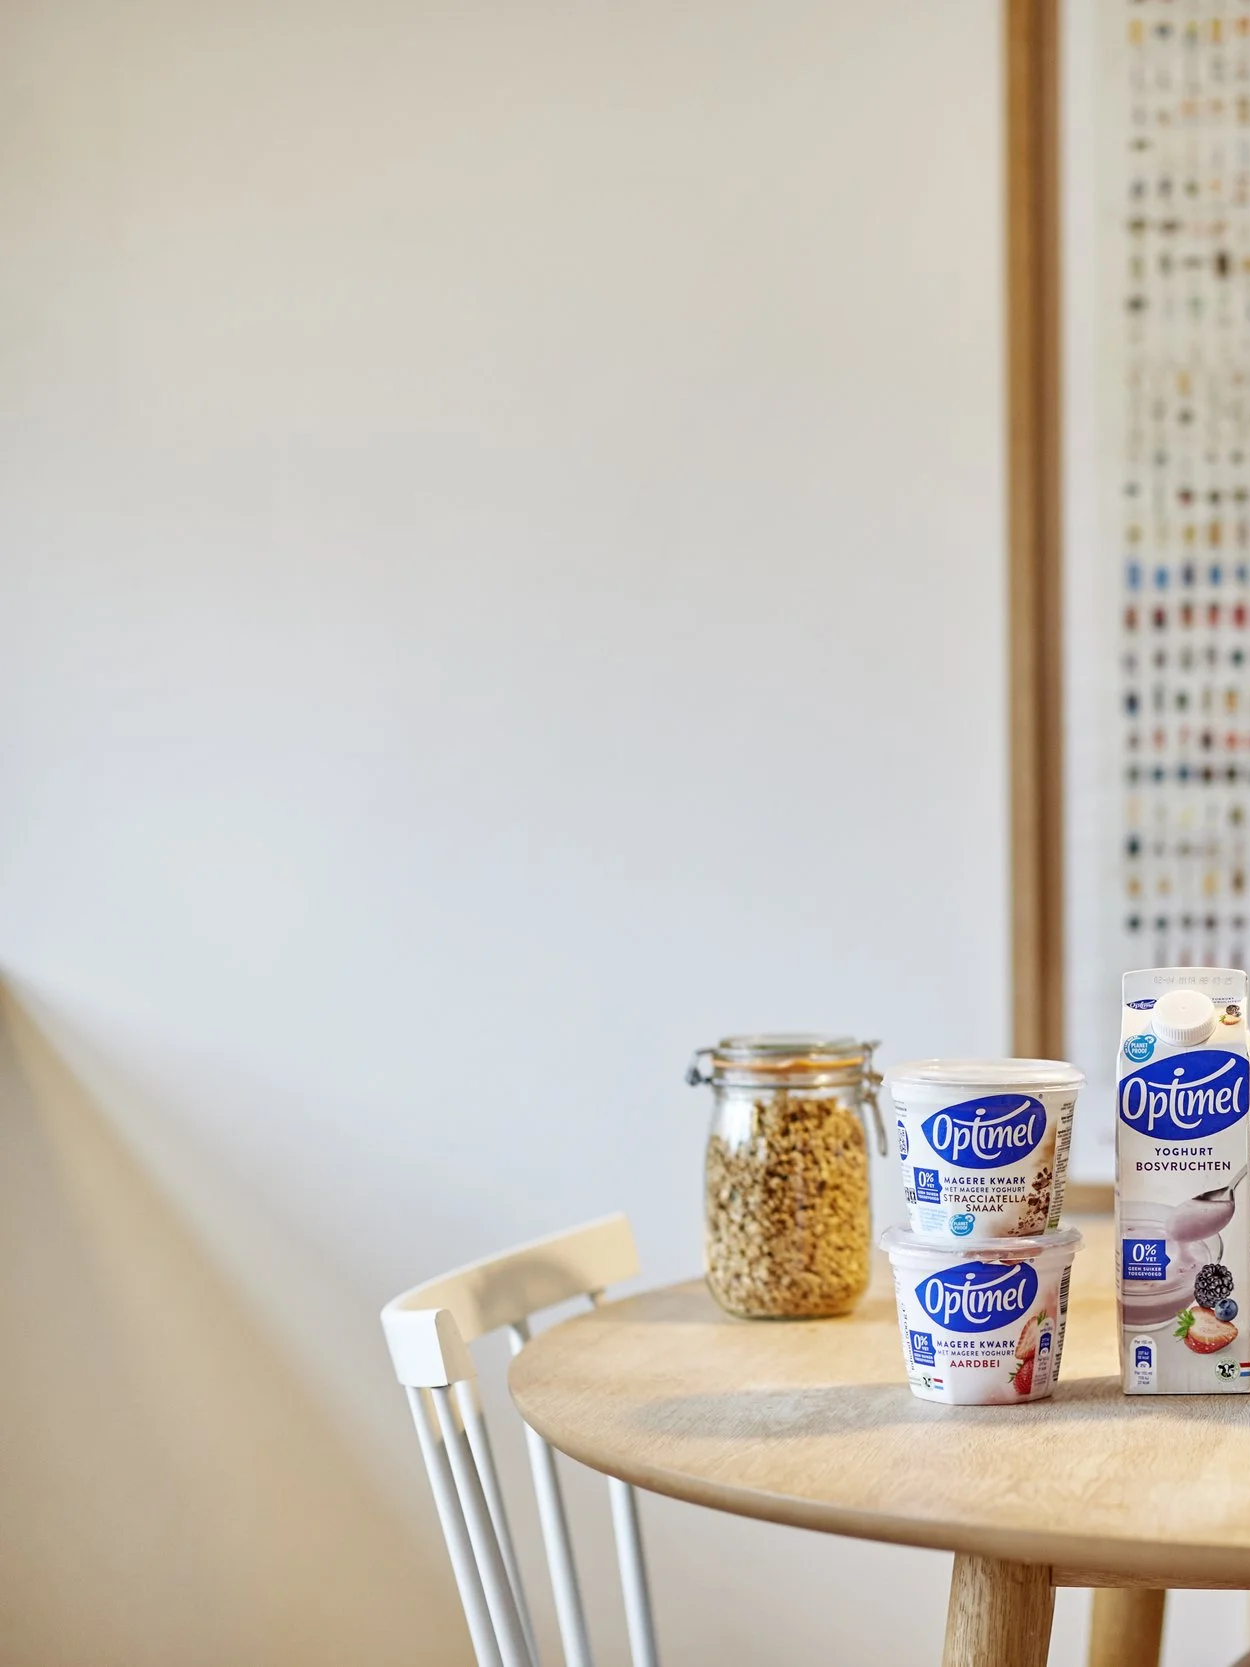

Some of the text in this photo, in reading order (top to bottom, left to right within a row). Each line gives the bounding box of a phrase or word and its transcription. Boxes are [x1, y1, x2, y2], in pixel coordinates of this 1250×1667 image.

[1122, 1058, 1243, 1131] Optimel
[932, 1100, 1036, 1160] Optimel
[1155, 1147, 1214, 1156] YOGHURT
[1136, 1161, 1231, 1171] BOSVRUCHTEN
[918, 1171, 935, 1187] 0%
[944, 1176, 1027, 1185] MAGERE KWARK
[943, 1193, 1027, 1203] STRACCIATELLA
[965, 1204, 1004, 1212] SMAAK
[1132, 1243, 1157, 1262] 0%
[925, 1265, 1027, 1324] Optimel
[913, 1334, 928, 1351] 0%
[937, 1340, 1016, 1348] MAGERE KWARK
[950, 1359, 1000, 1368] AARDBEI
